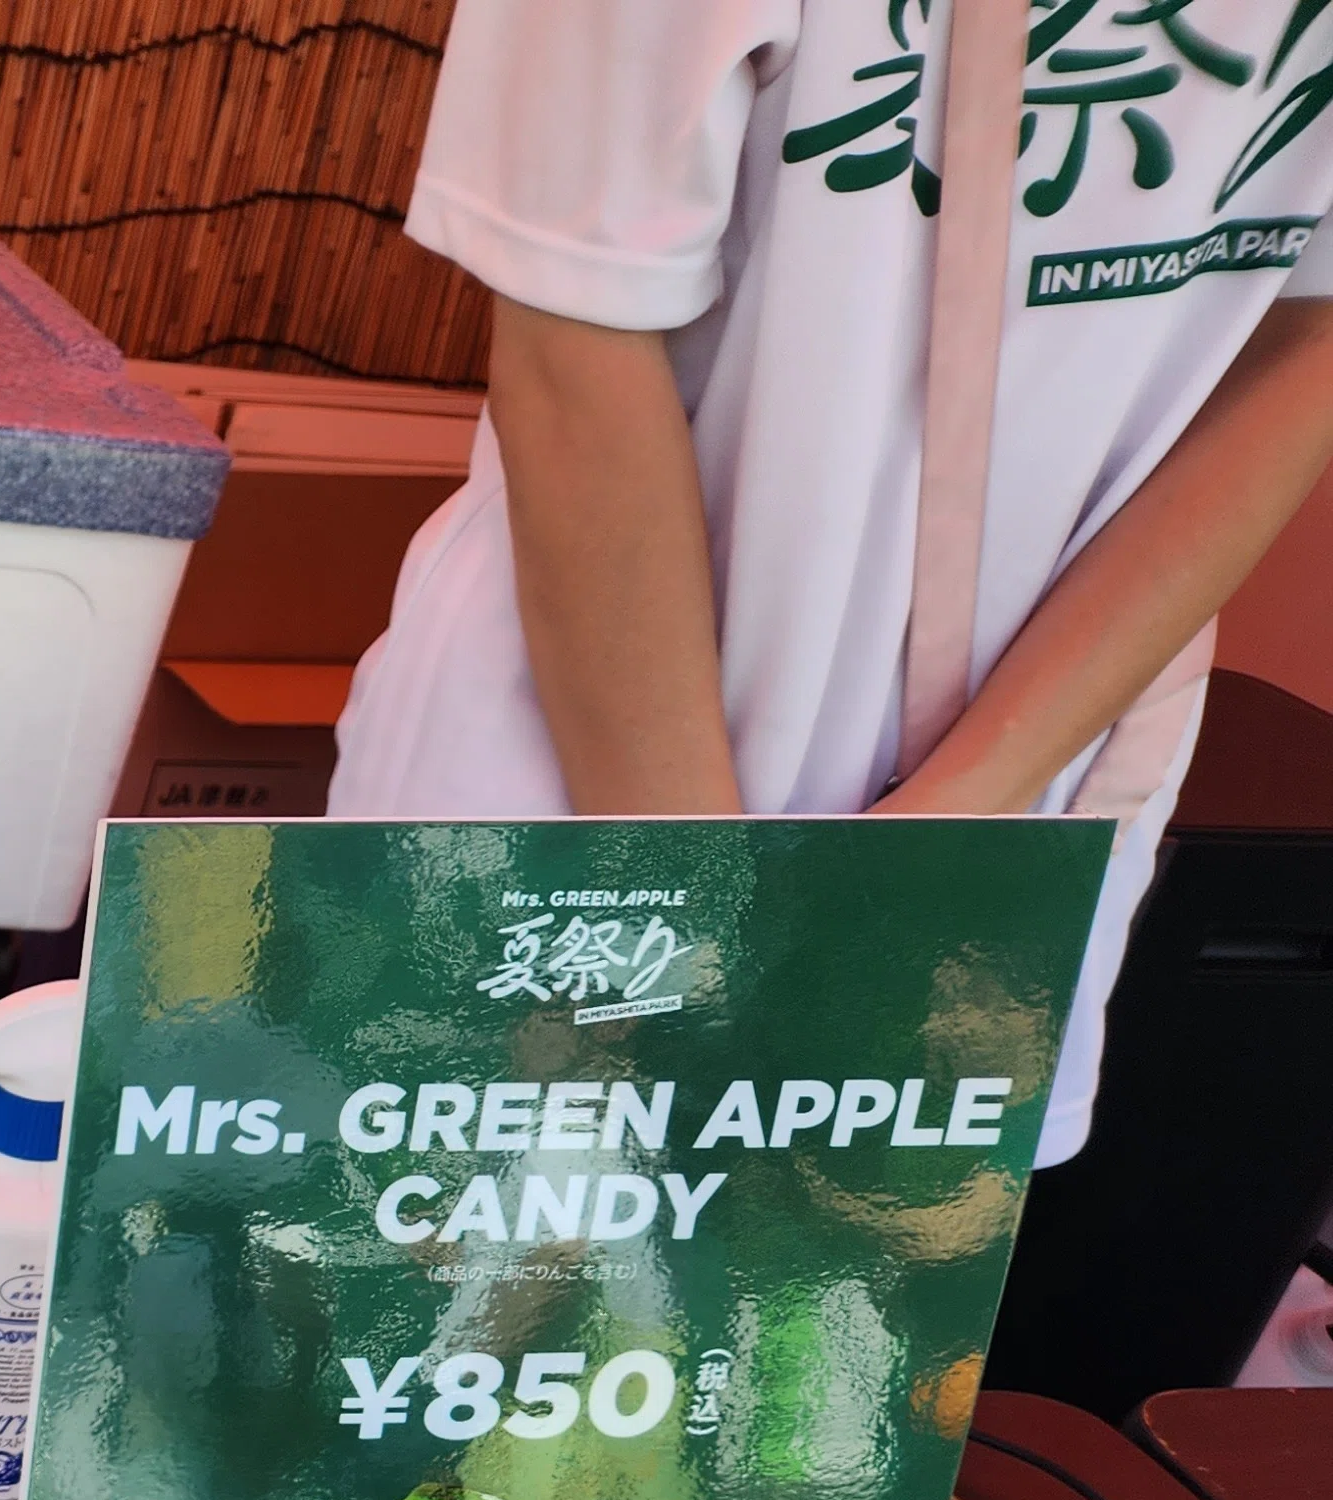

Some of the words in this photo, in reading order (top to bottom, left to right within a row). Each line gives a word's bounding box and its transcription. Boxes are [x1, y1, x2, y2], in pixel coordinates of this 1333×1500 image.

[1038, 263, 1084, 295] IN
[1233, 227, 1313, 260] PAR
[501, 890, 544, 907] Mrs.
[550, 890, 618, 907] GREEN
[620, 890, 687, 907] APPLE
[476, 912, 694, 1002] 夏祭り
[114, 1084, 305, 1156] Mrs.
[338, 1081, 673, 1154] GREEN
[692, 1077, 1011, 1149] APPLE
[375, 1172, 728, 1243] CANDY
[339, 1351, 676, 1442] ¥850
